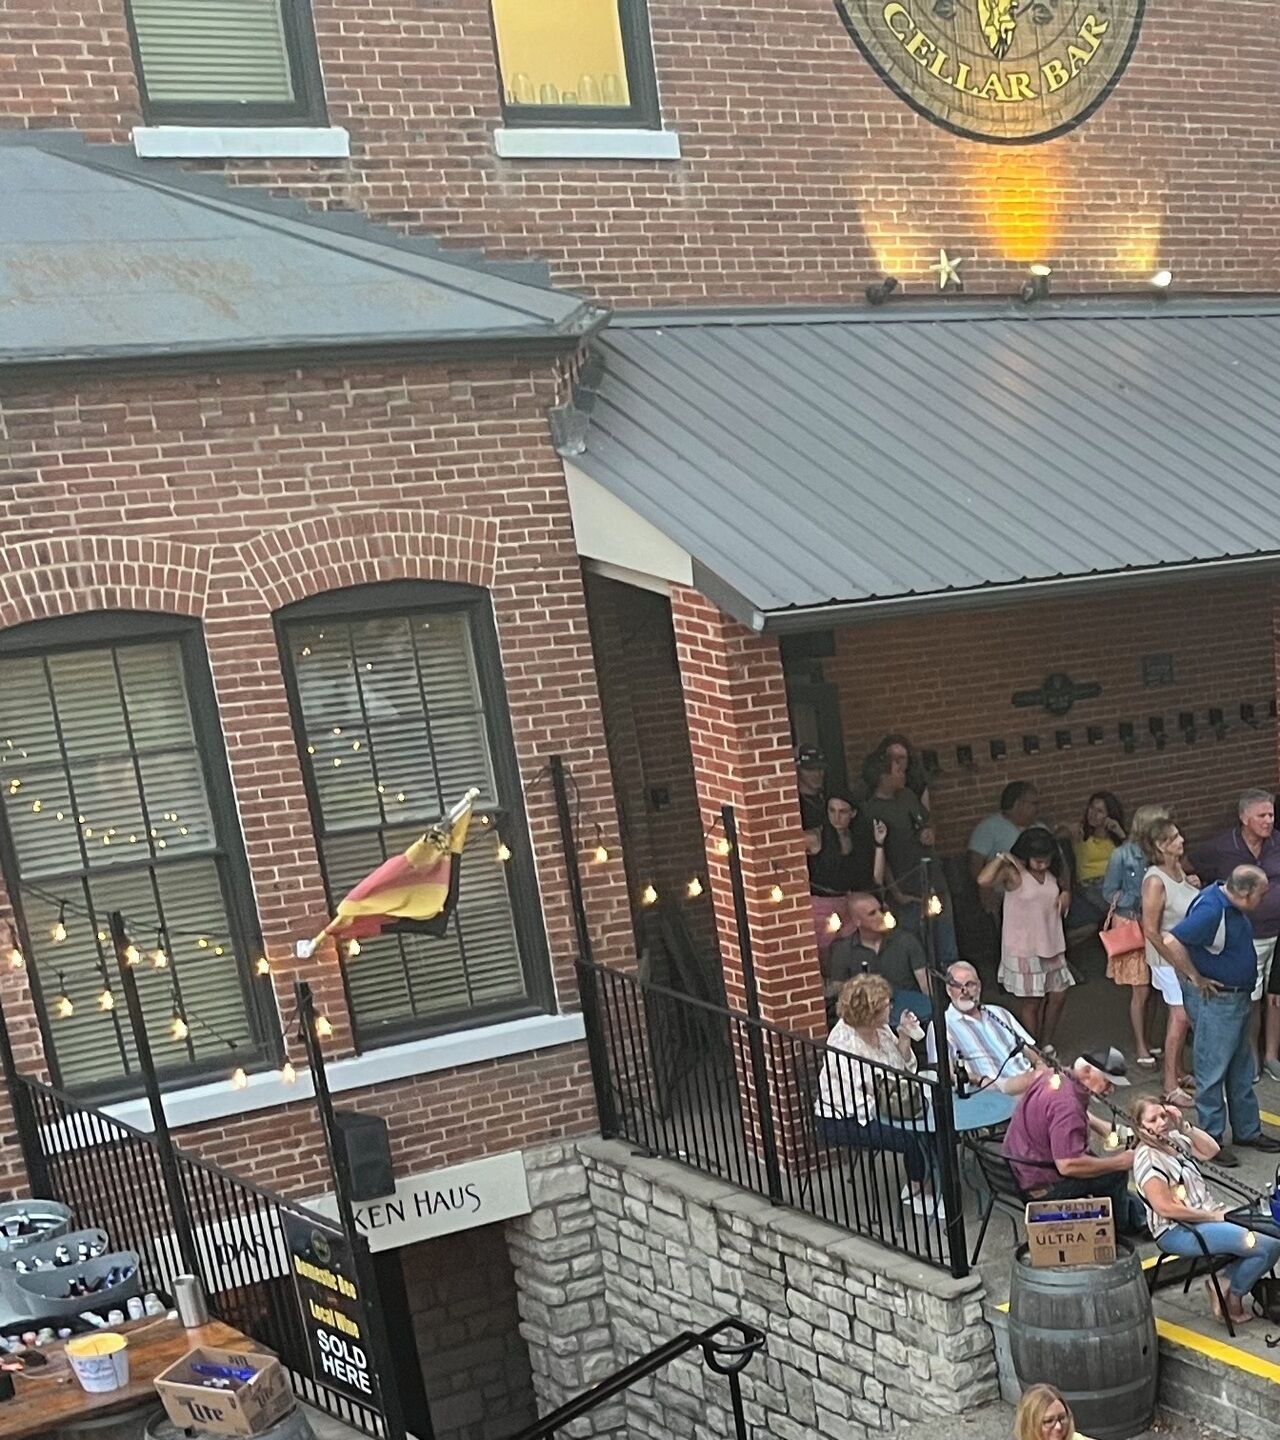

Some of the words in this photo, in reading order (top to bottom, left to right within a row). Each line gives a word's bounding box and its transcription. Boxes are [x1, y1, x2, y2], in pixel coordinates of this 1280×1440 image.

[883, 2, 1038, 102] CELLAR
[1042, 14, 1109, 93] BAR
[414, 1182, 482, 1218] HAUS
[1035, 1231, 1088, 1246] ULTRA
[316, 1328, 368, 1370] SOLD
[320, 1351, 373, 1395] HERE
[184, 1399, 224, 1424] Lite
